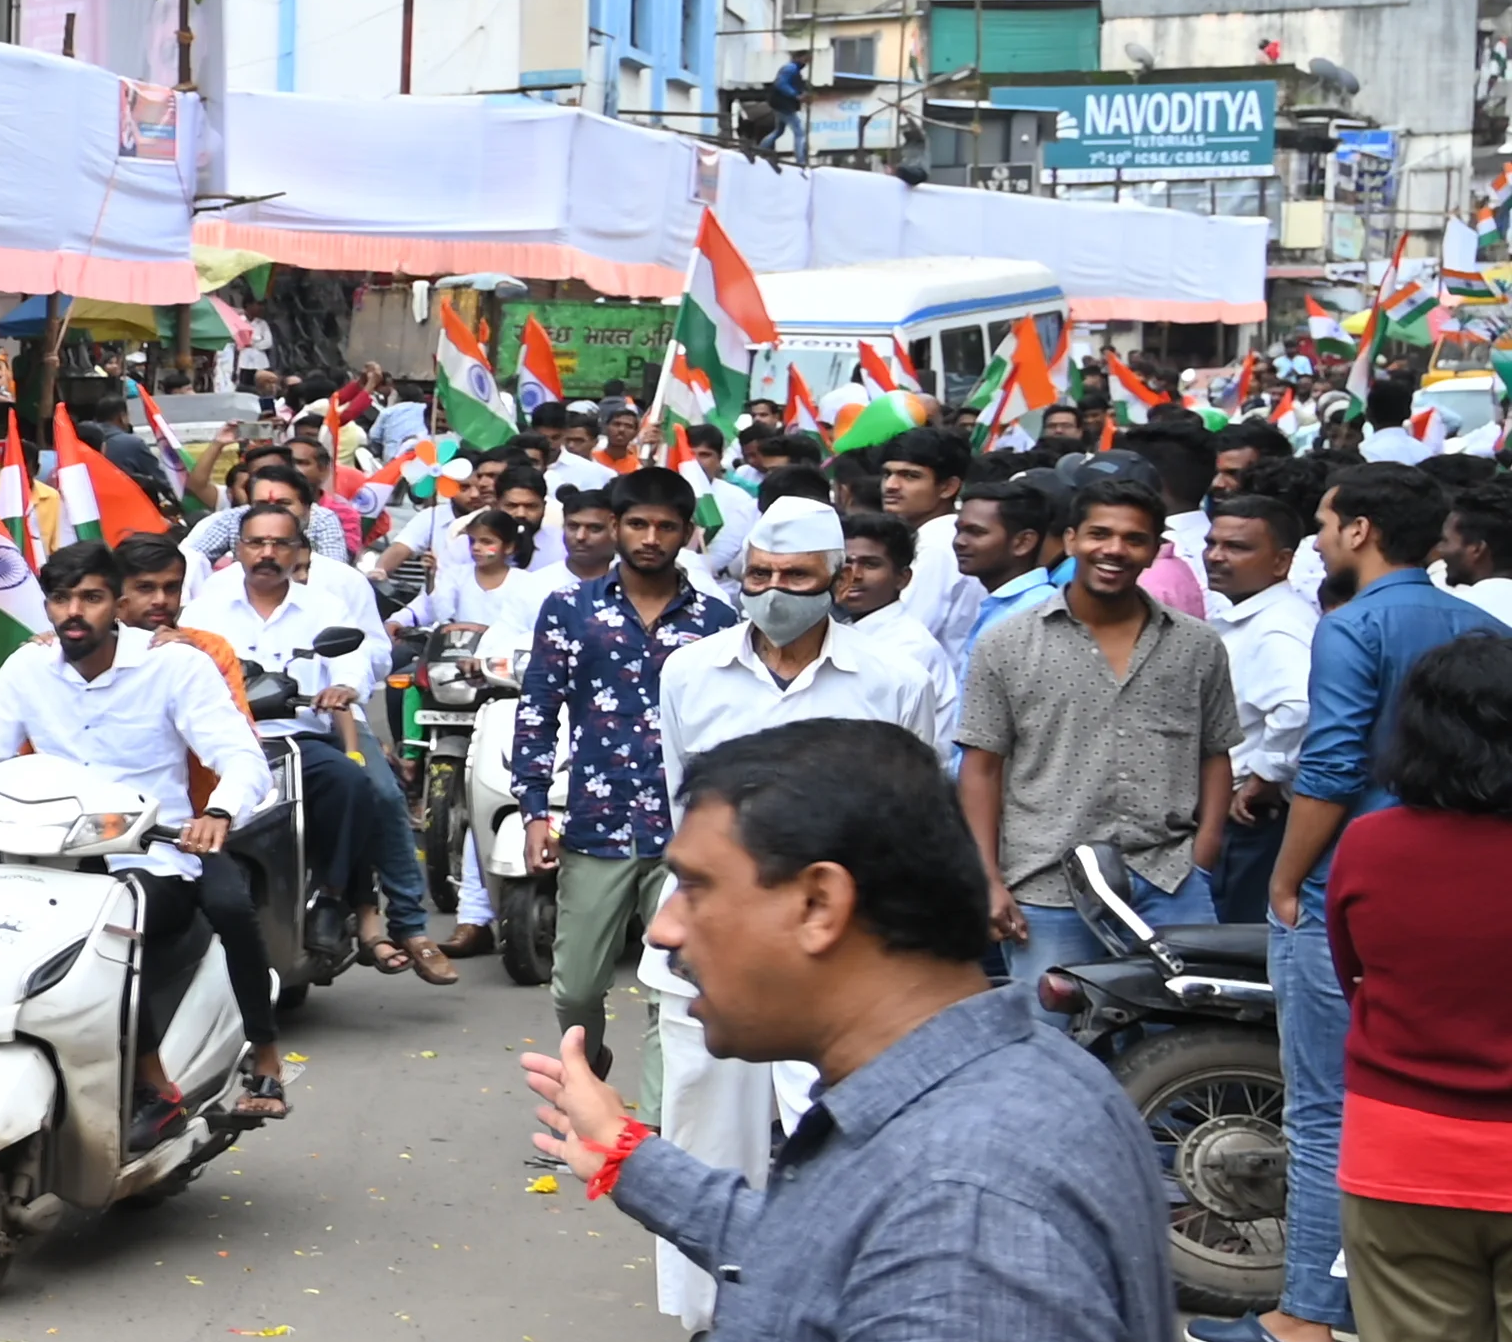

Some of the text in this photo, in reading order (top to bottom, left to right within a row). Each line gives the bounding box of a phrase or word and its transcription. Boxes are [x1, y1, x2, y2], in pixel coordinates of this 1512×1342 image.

[1085, 89, 1263, 135] NAVODITYA
[1133, 135, 1206, 147] TUTORIALS
[1134, 150, 1250, 164] ICSE/CBSE/SSC
